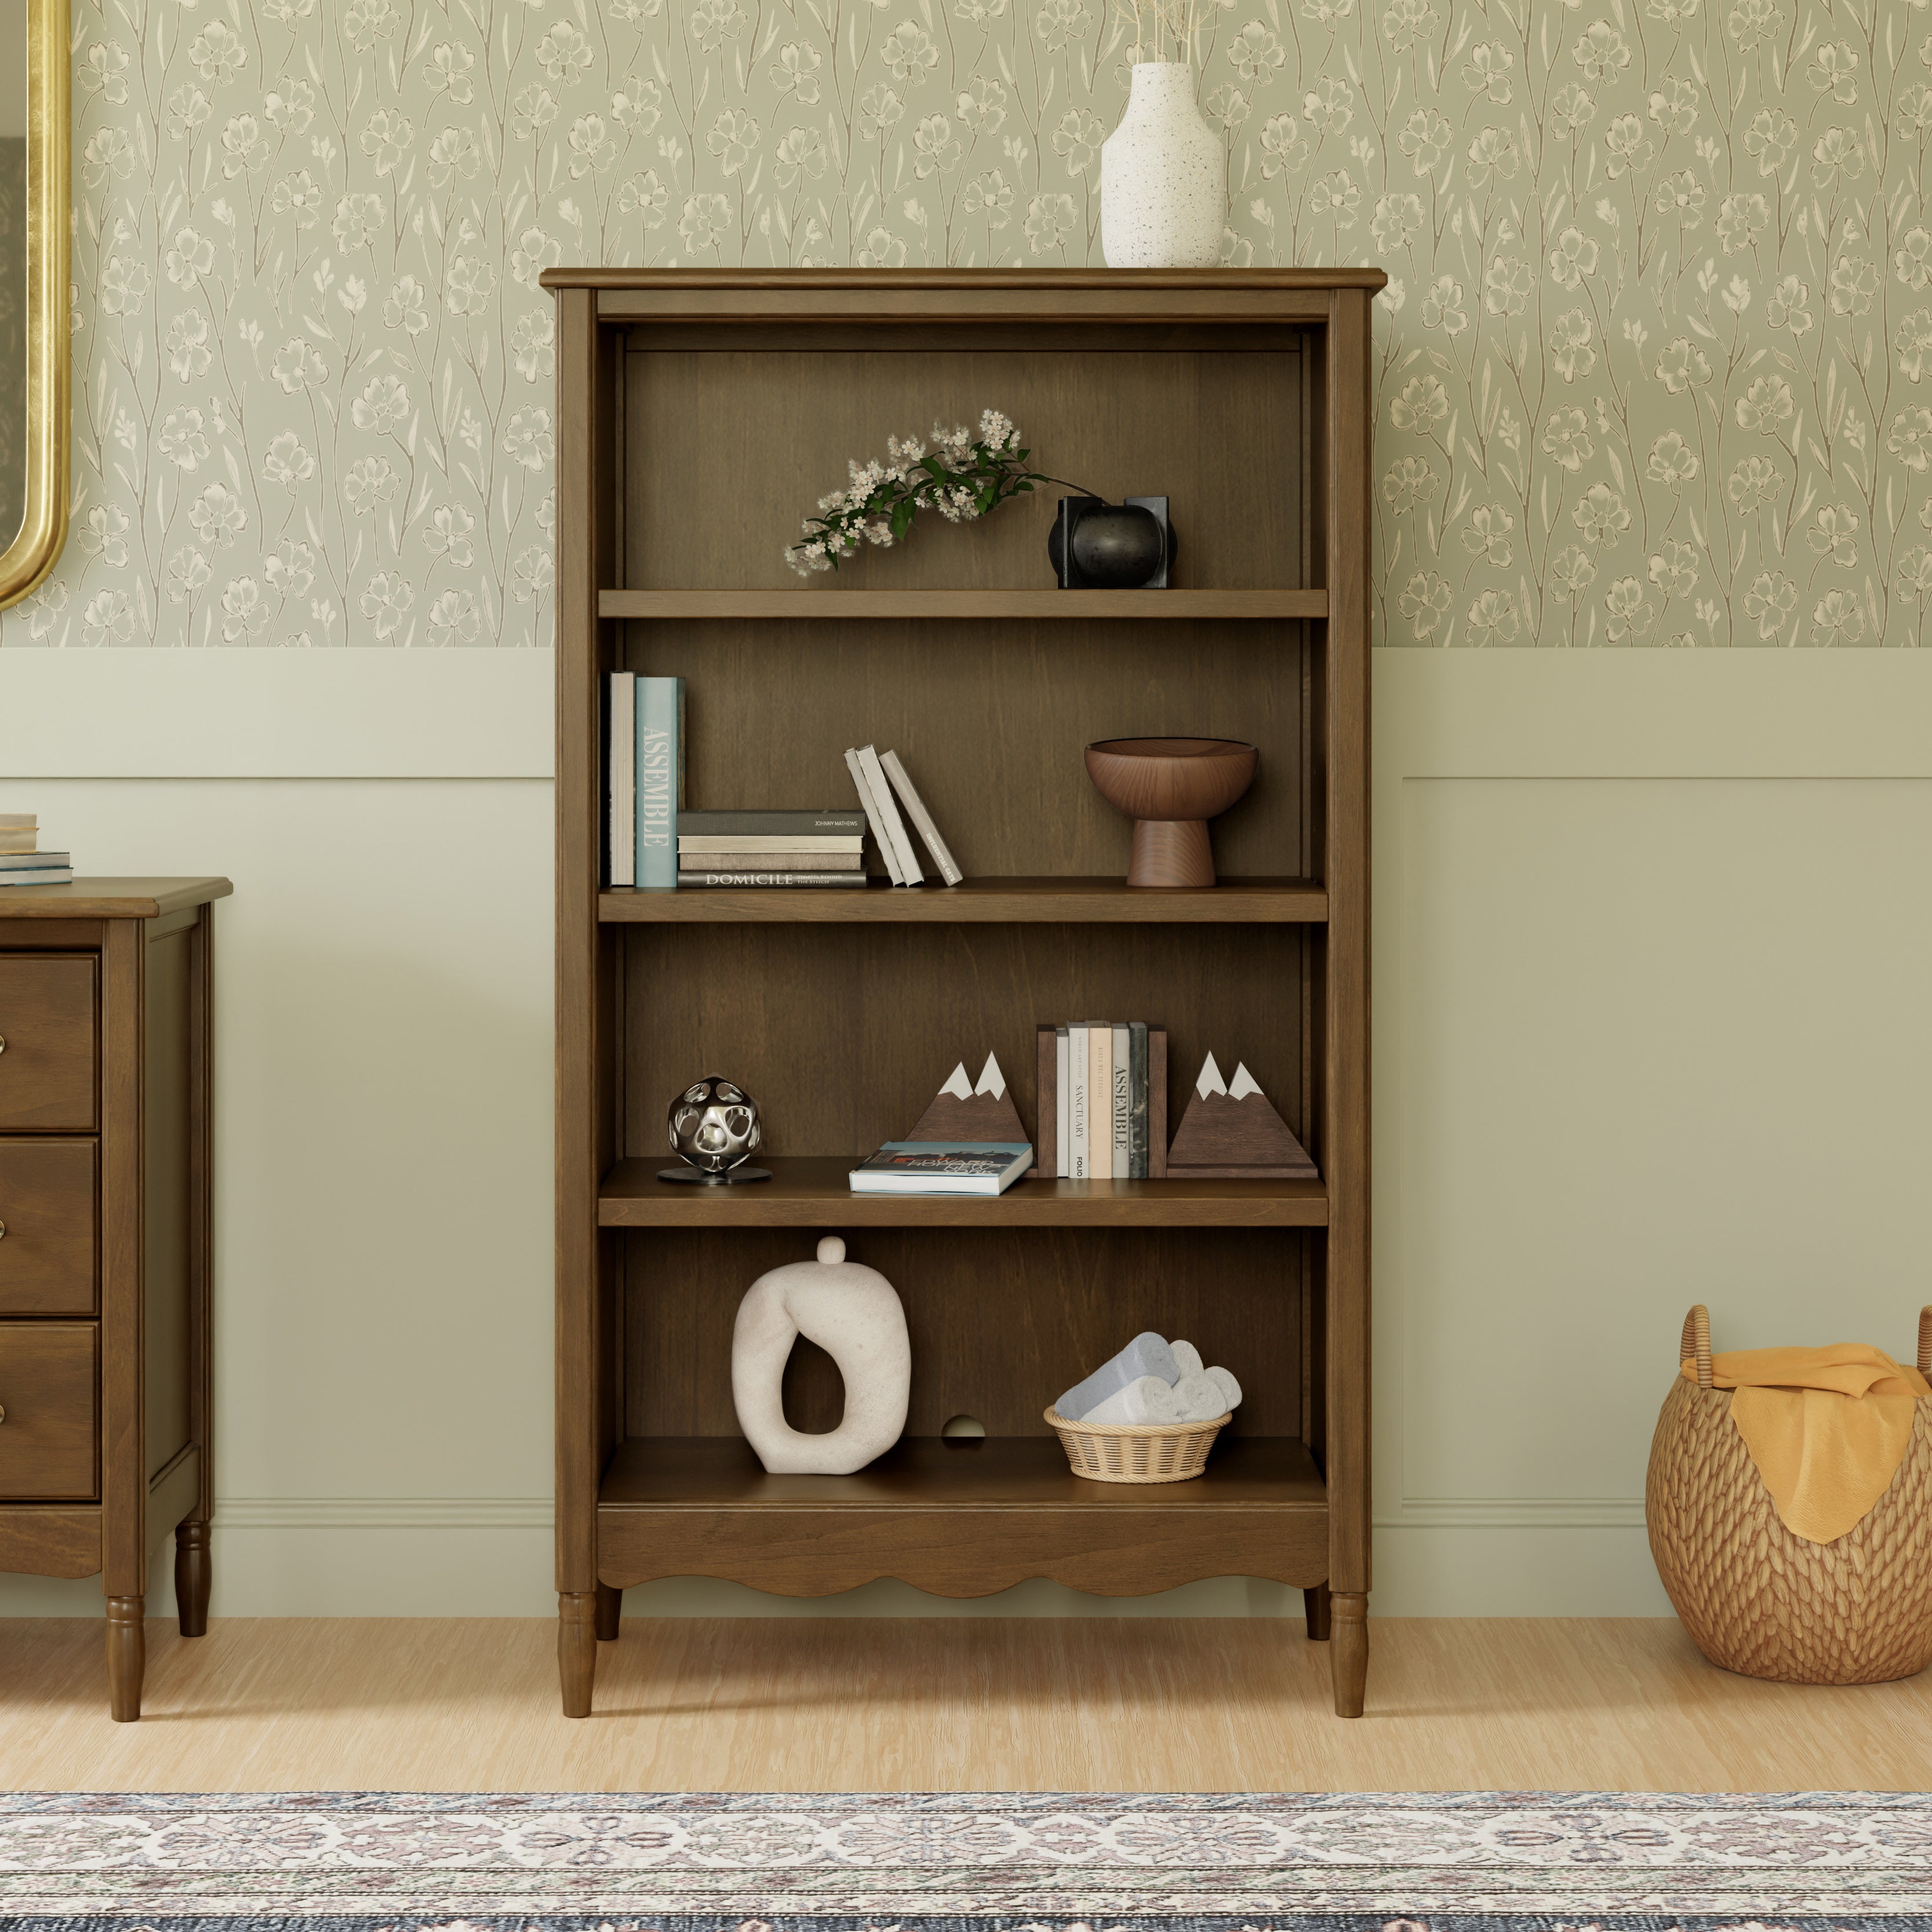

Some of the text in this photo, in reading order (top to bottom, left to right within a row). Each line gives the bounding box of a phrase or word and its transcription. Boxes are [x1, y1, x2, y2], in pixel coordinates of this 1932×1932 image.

[643, 726, 669, 847] ASSEMBLE
[705, 874, 793, 885] DOMICILE
[926, 833, 956, 882] INFLUENTIAL CATS
[1075, 1085, 1083, 1139] SANCTUARY
[1115, 1065, 1127, 1149] ASSEMBLE
